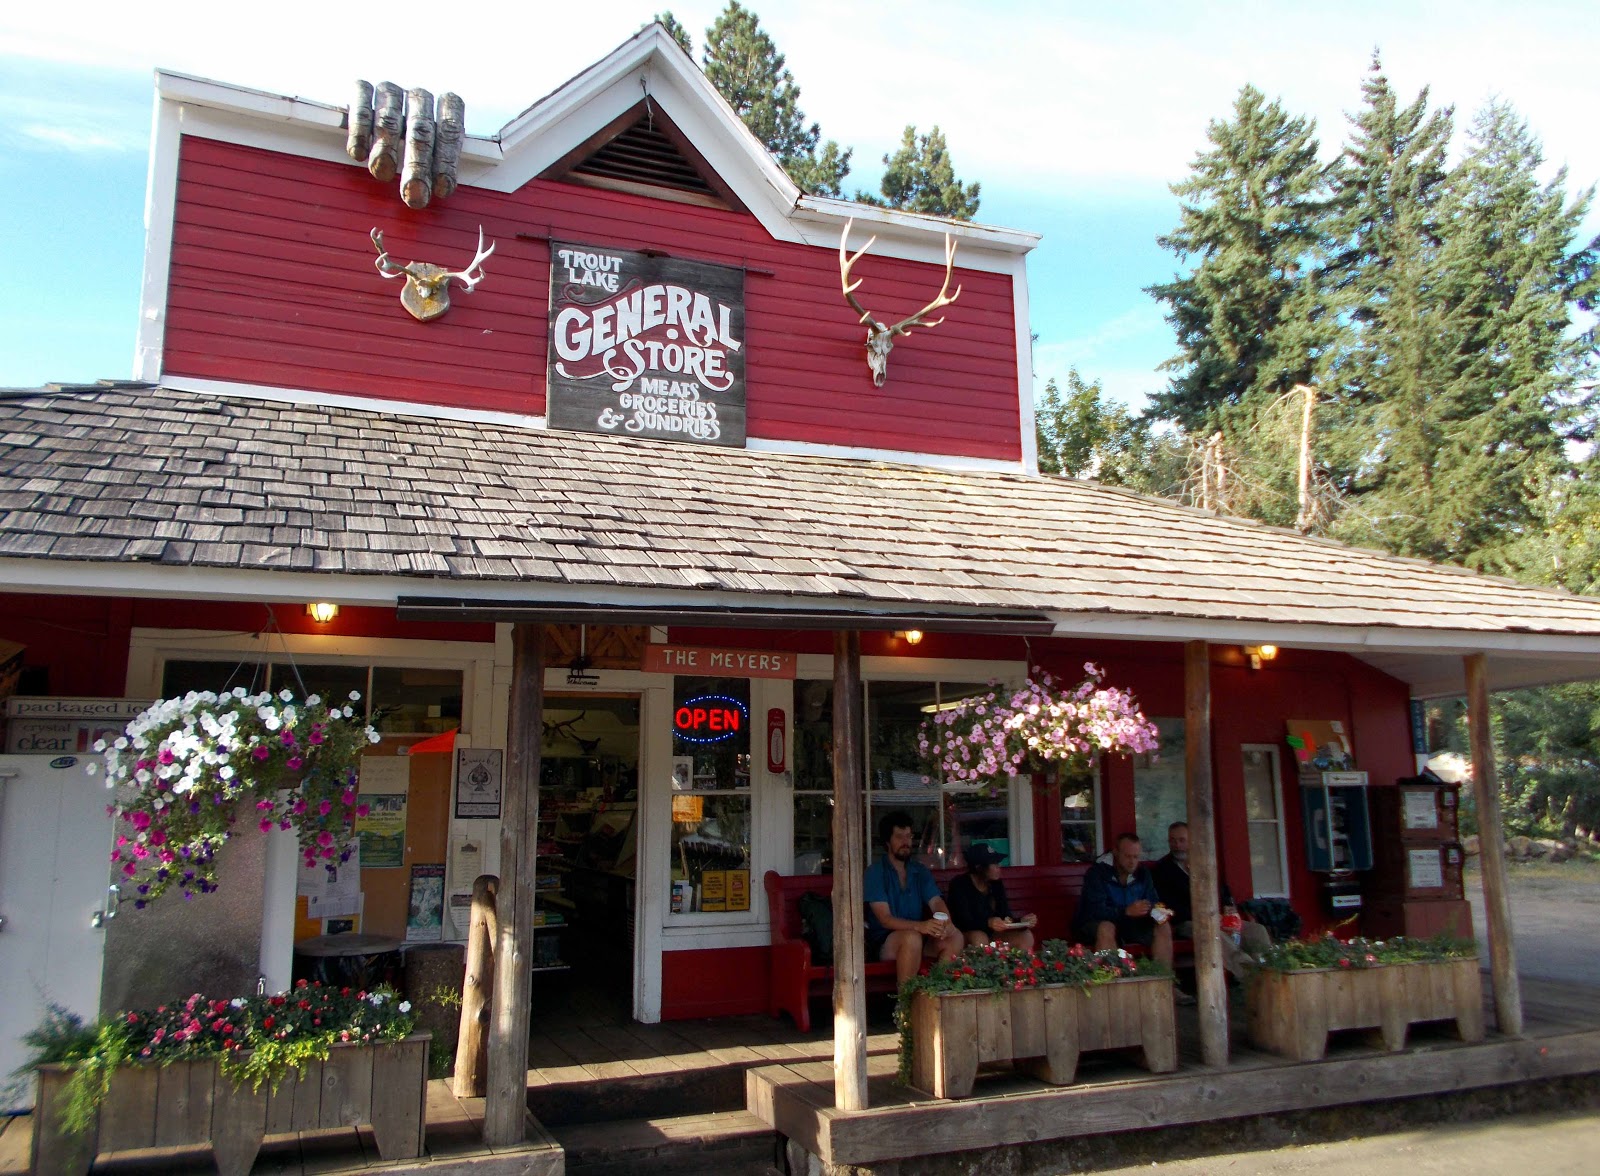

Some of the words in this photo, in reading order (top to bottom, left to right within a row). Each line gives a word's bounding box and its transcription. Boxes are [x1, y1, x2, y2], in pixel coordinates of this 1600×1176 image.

[558, 249, 623, 273] TROUT
[569, 268, 619, 293] LAKE
[554, 284, 742, 362] GENERAL
[603, 338, 734, 392] STORE
[641, 377, 700, 401] MEATS
[619, 393, 717, 420] GROCERIES
[597, 407, 624, 429] &
[625, 410, 721, 439] SUNDRIES
[662, 649, 698, 667] THE
[710, 652, 789, 671] MEYERS'
[17, 702, 118, 715] packaged
[675, 707, 740, 731] OPEN
[22, 723, 71, 733] crystal
[18, 734, 72, 750] clear
